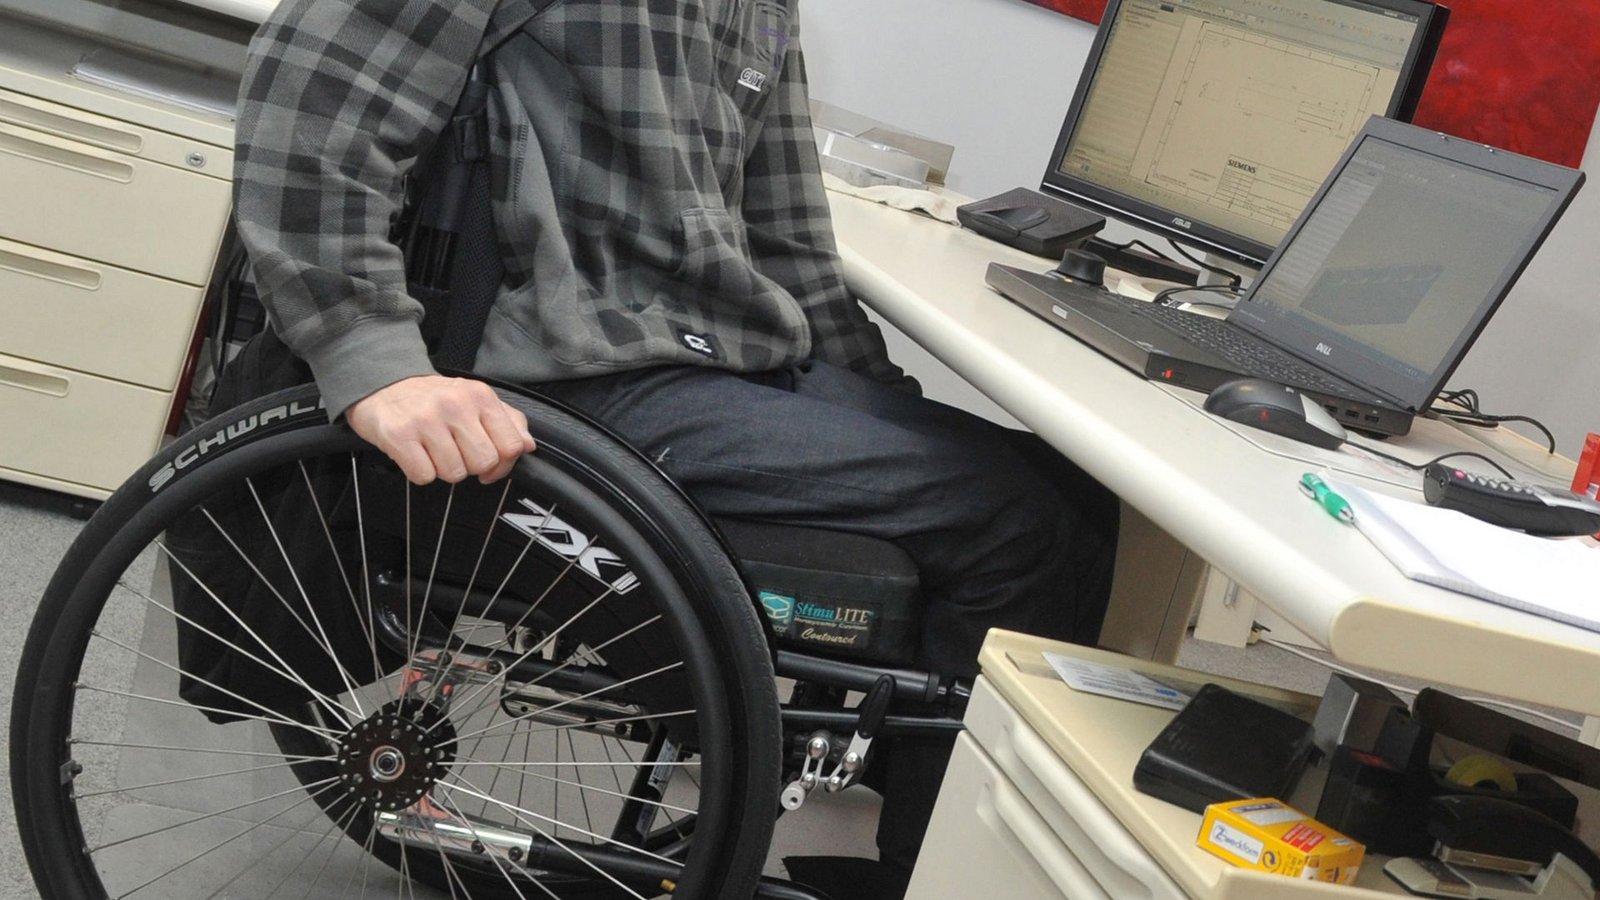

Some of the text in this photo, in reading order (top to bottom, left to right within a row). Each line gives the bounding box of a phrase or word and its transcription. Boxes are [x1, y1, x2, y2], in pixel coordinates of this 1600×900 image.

[1228, 159, 1256, 174] SIEMENS
[1172, 217, 1192, 229] ASUS
[149, 401, 326, 493] SCHWAL
